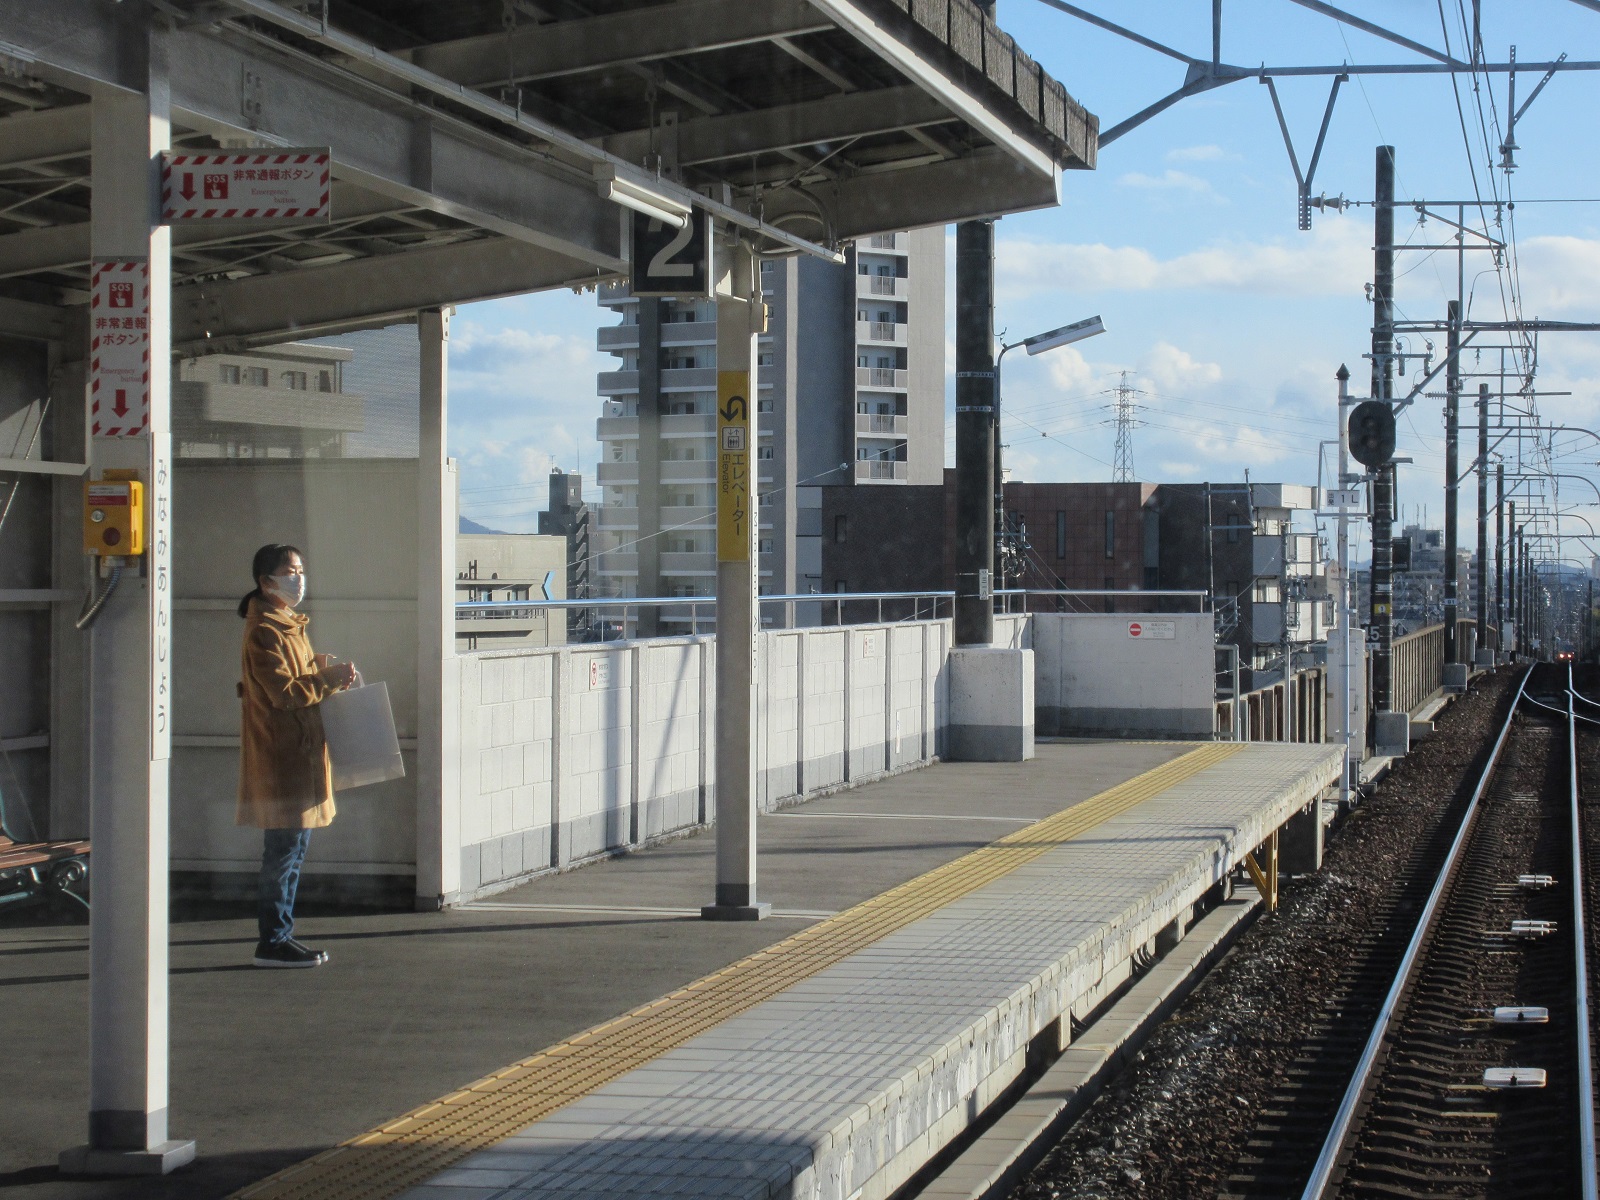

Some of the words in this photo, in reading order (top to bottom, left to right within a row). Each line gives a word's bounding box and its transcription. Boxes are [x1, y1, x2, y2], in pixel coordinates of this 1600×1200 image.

[206, 175, 226, 183] SOS
[233, 169, 315, 181] 非常通報ボタン
[647, 213, 694, 277] 2
[111, 283, 131, 292] SOS
[95, 317, 147, 330] 非常通報
[102, 333, 140, 346] ボタン
[722, 454, 731, 494] Elevator
[732, 454, 745, 536] エレベーター
[157, 458, 167, 733] みなみあんじょう
